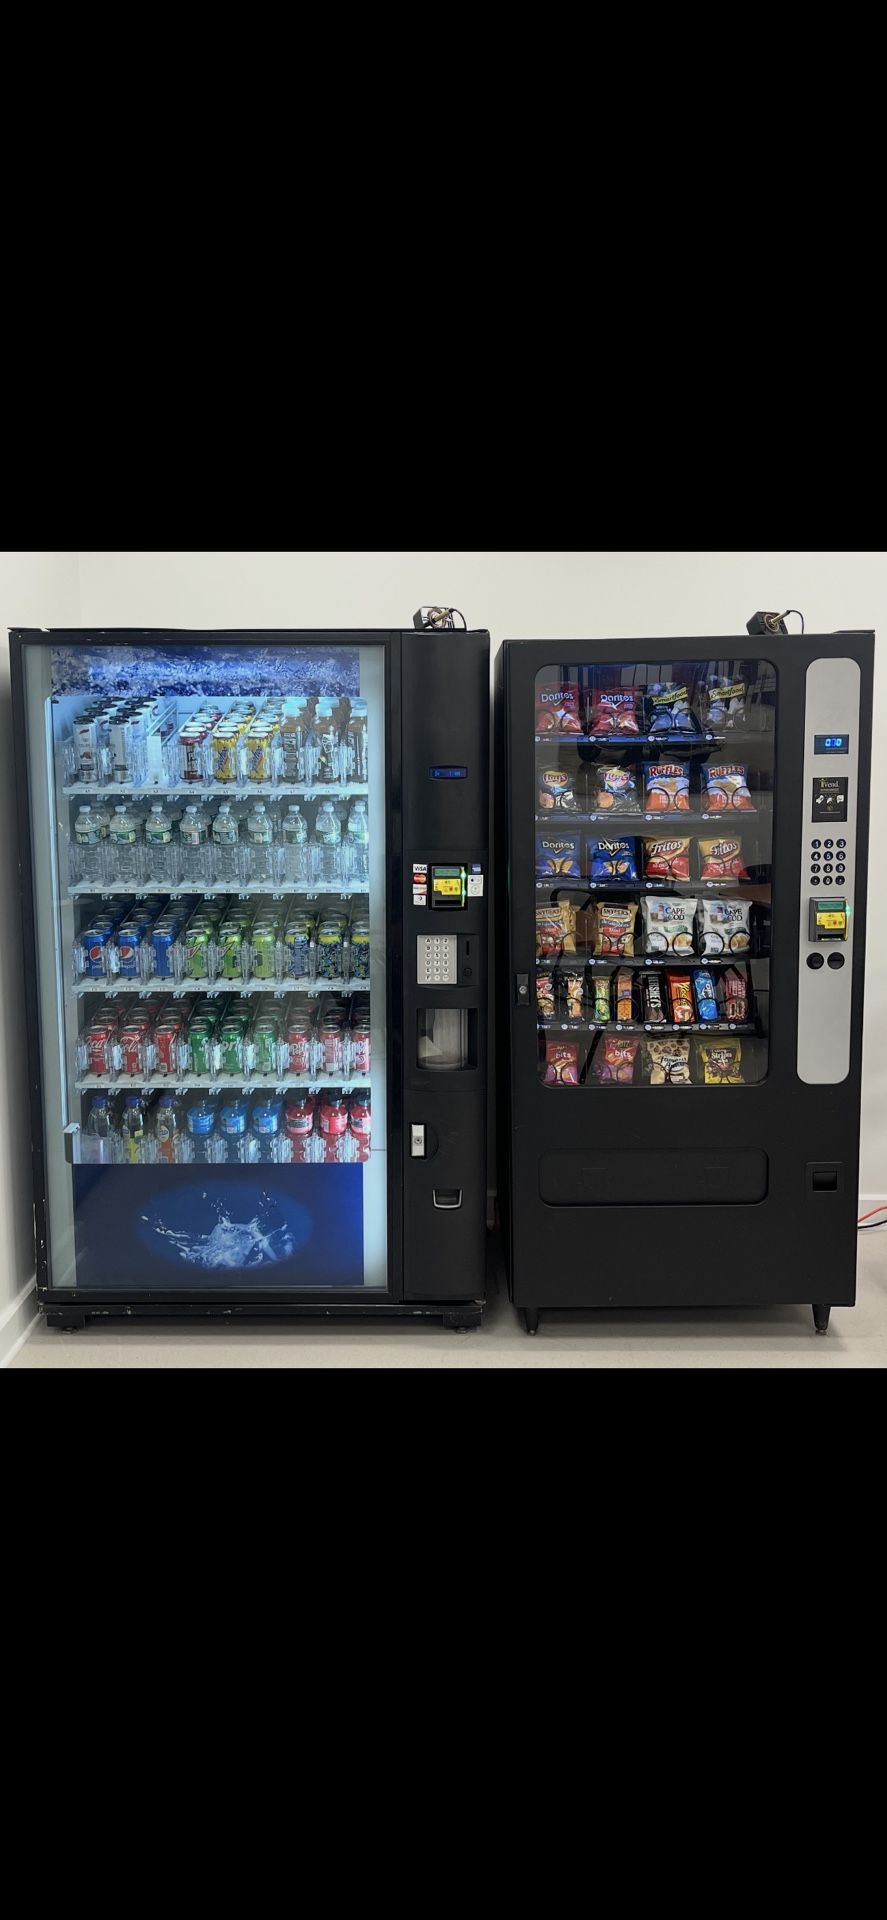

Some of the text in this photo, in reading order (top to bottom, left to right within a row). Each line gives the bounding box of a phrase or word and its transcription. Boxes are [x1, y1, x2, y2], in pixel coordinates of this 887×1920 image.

[711, 685, 745, 699] Smartfood
[541, 692, 574, 703] Doritos
[600, 694, 634, 703] Doritos
[649, 764, 684, 777] RUFFLES
[708, 766, 745, 779] RUFFLES
[542, 841, 575, 850] Doritos
[665, 907, 687, 915] CAPE
[614, 1050, 631, 1058] bits
